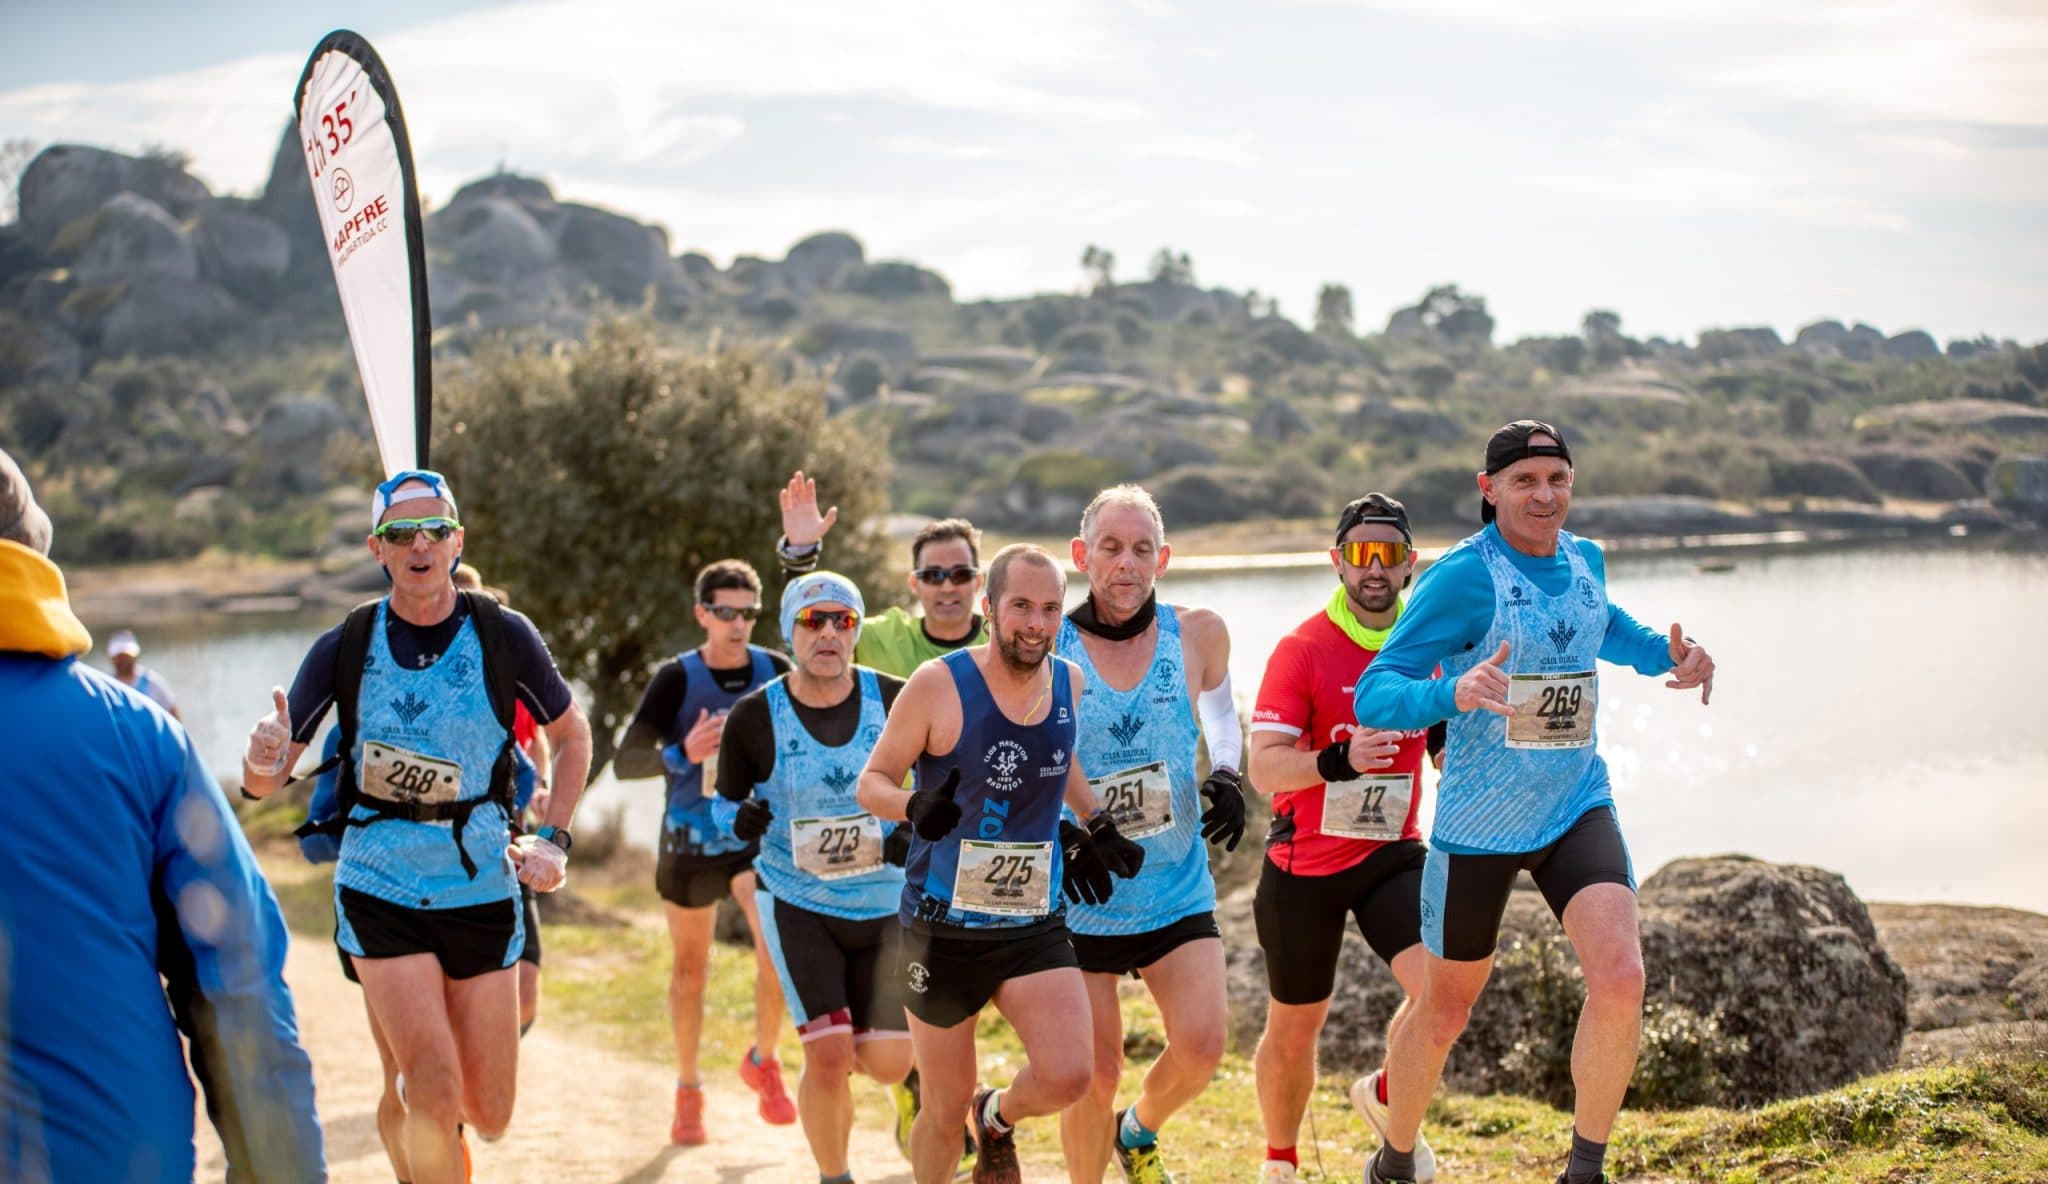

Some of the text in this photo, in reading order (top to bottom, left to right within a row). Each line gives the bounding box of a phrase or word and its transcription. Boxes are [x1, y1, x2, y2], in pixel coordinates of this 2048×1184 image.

[1504, 599, 1532, 608] VIATOR
[1536, 684, 1582, 717] 269
[385, 761, 438, 794] 268
[986, 777, 1023, 791] BADAJOZ
[1105, 778, 1143, 813] 251
[1361, 786, 1387, 812] 17
[818, 826, 860, 854] 273
[984, 855, 1036, 885] 275
